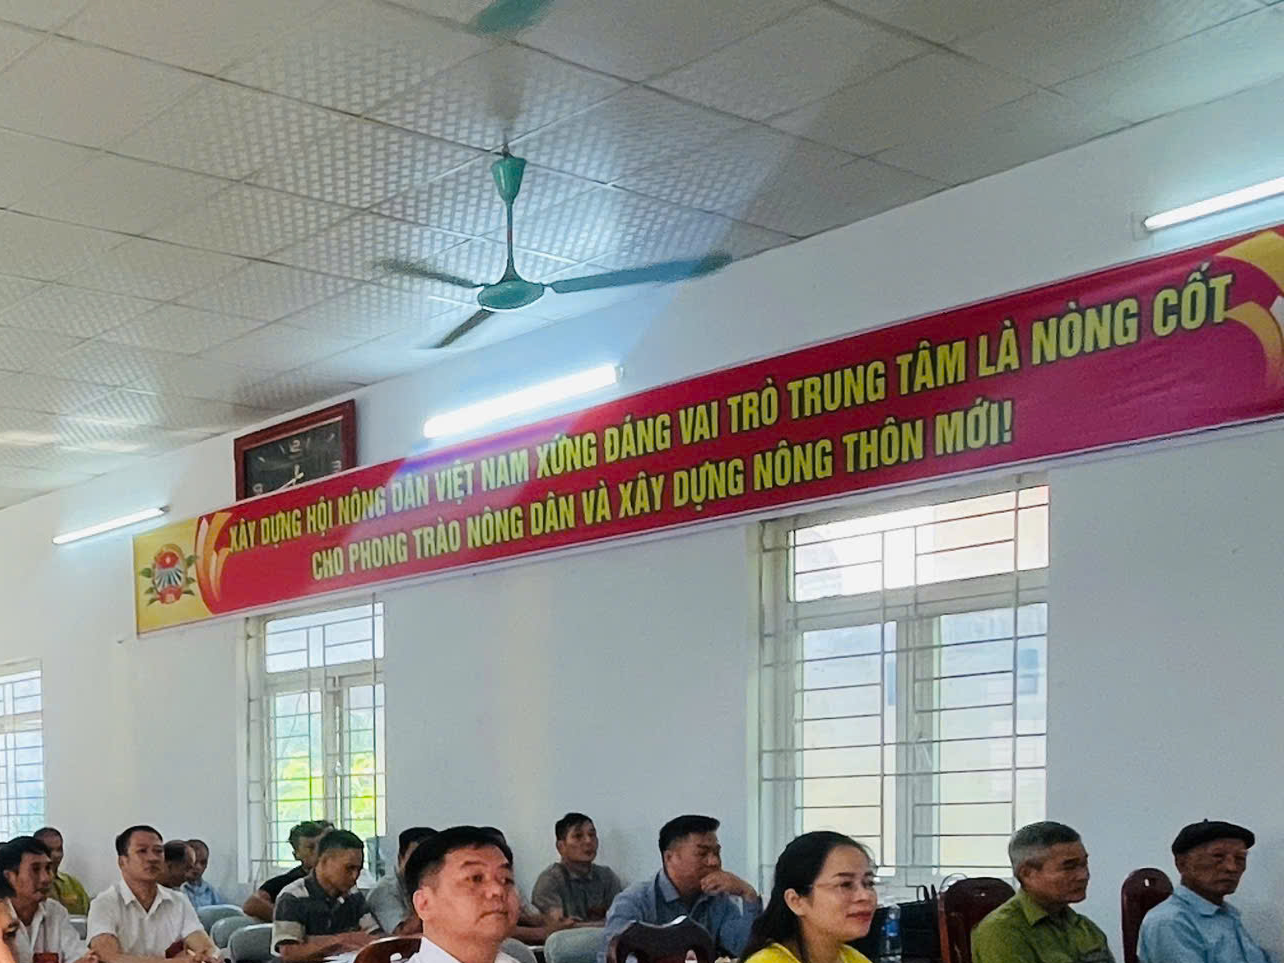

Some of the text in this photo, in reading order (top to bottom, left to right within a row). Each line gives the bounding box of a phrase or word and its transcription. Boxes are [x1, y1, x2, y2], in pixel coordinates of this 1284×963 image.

[229, 261, 1233, 552] XÂY DỰNG HỘI NÔNG DÂN VIỆT NAM XỨNG ĐÁNG VAI TRÒ TRUNG TÂM LÀ NÒNG CỐT
[312, 397, 1012, 580] CHO PHONG TRÀO NÔNG DÂN VÀ XÂY DỰNG NÔNG THÔN MỚI!
